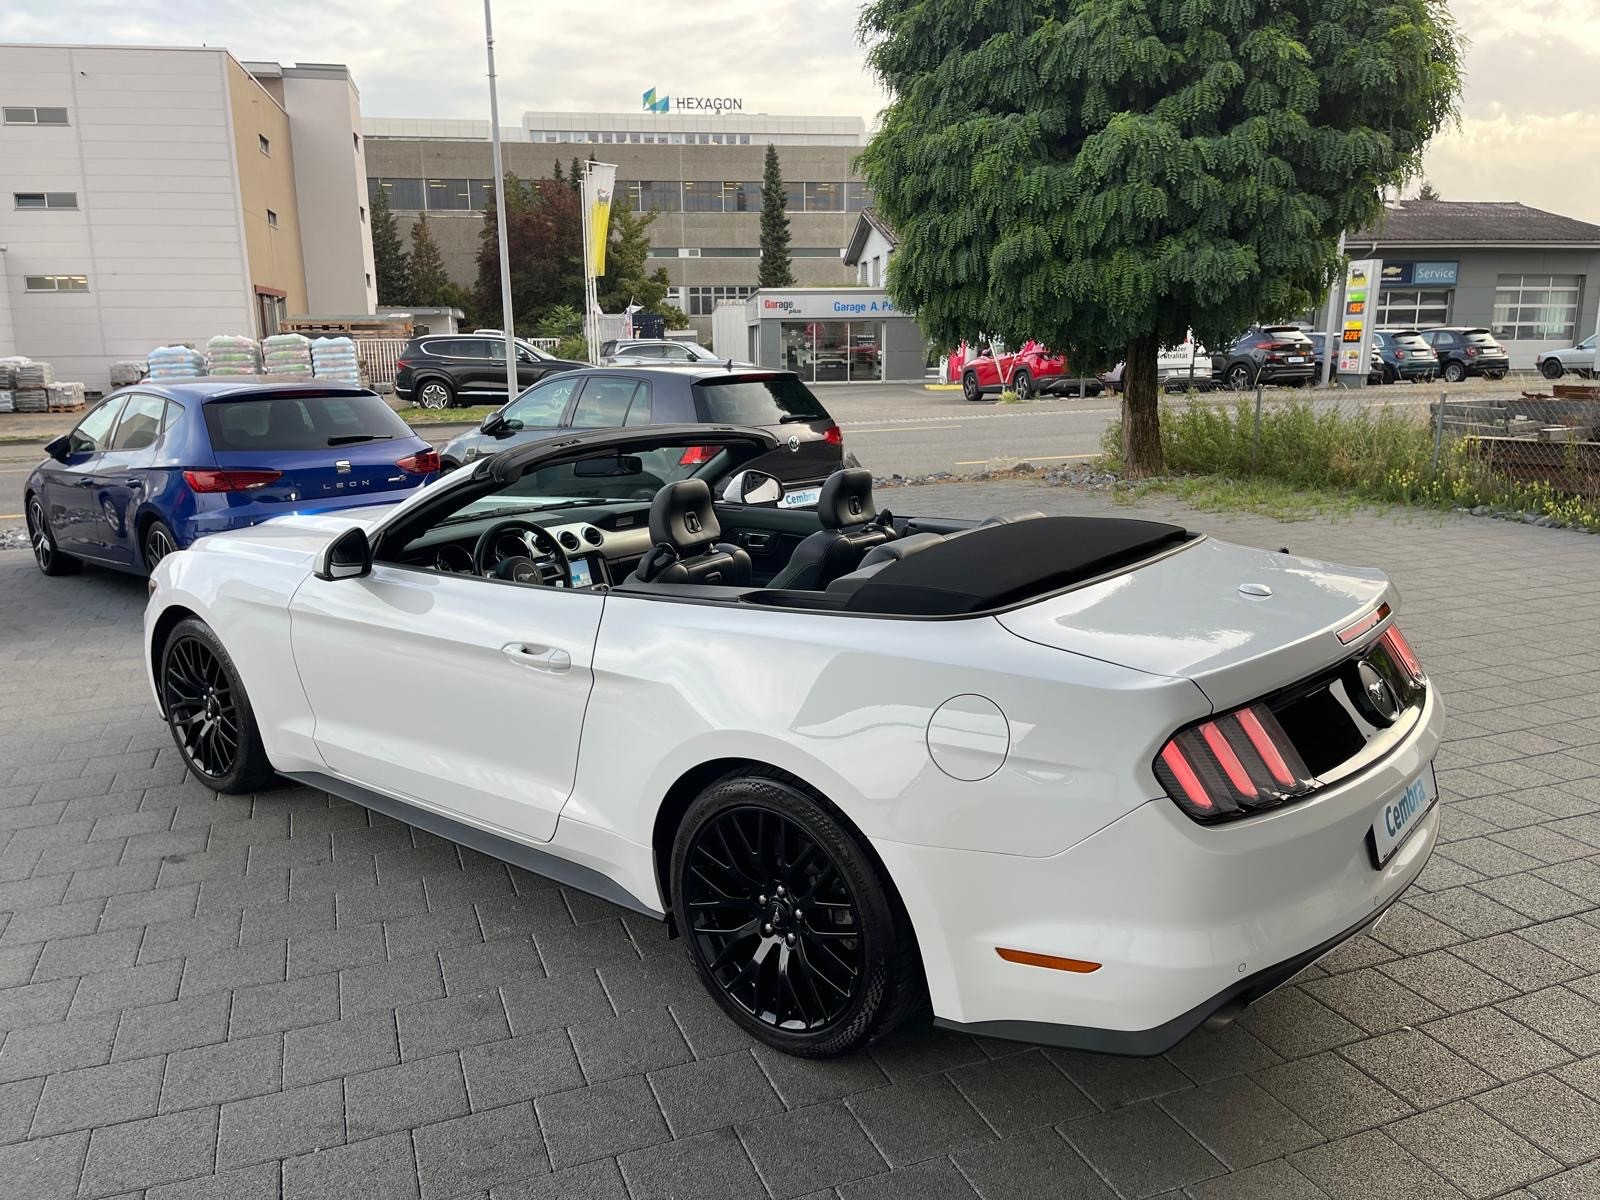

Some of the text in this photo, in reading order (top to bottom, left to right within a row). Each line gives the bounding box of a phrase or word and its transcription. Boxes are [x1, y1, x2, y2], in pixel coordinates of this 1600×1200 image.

[676, 97, 742, 110] HEXAGON
[1418, 267, 1455, 279] Service
[765, 300, 793, 310] Garage
[834, 301, 866, 313] Garage
[870, 301, 880, 311] A.
[323, 479, 370, 489] LEON
[785, 492, 817, 505] Cembra
[1386, 780, 1426, 837] Cembra
